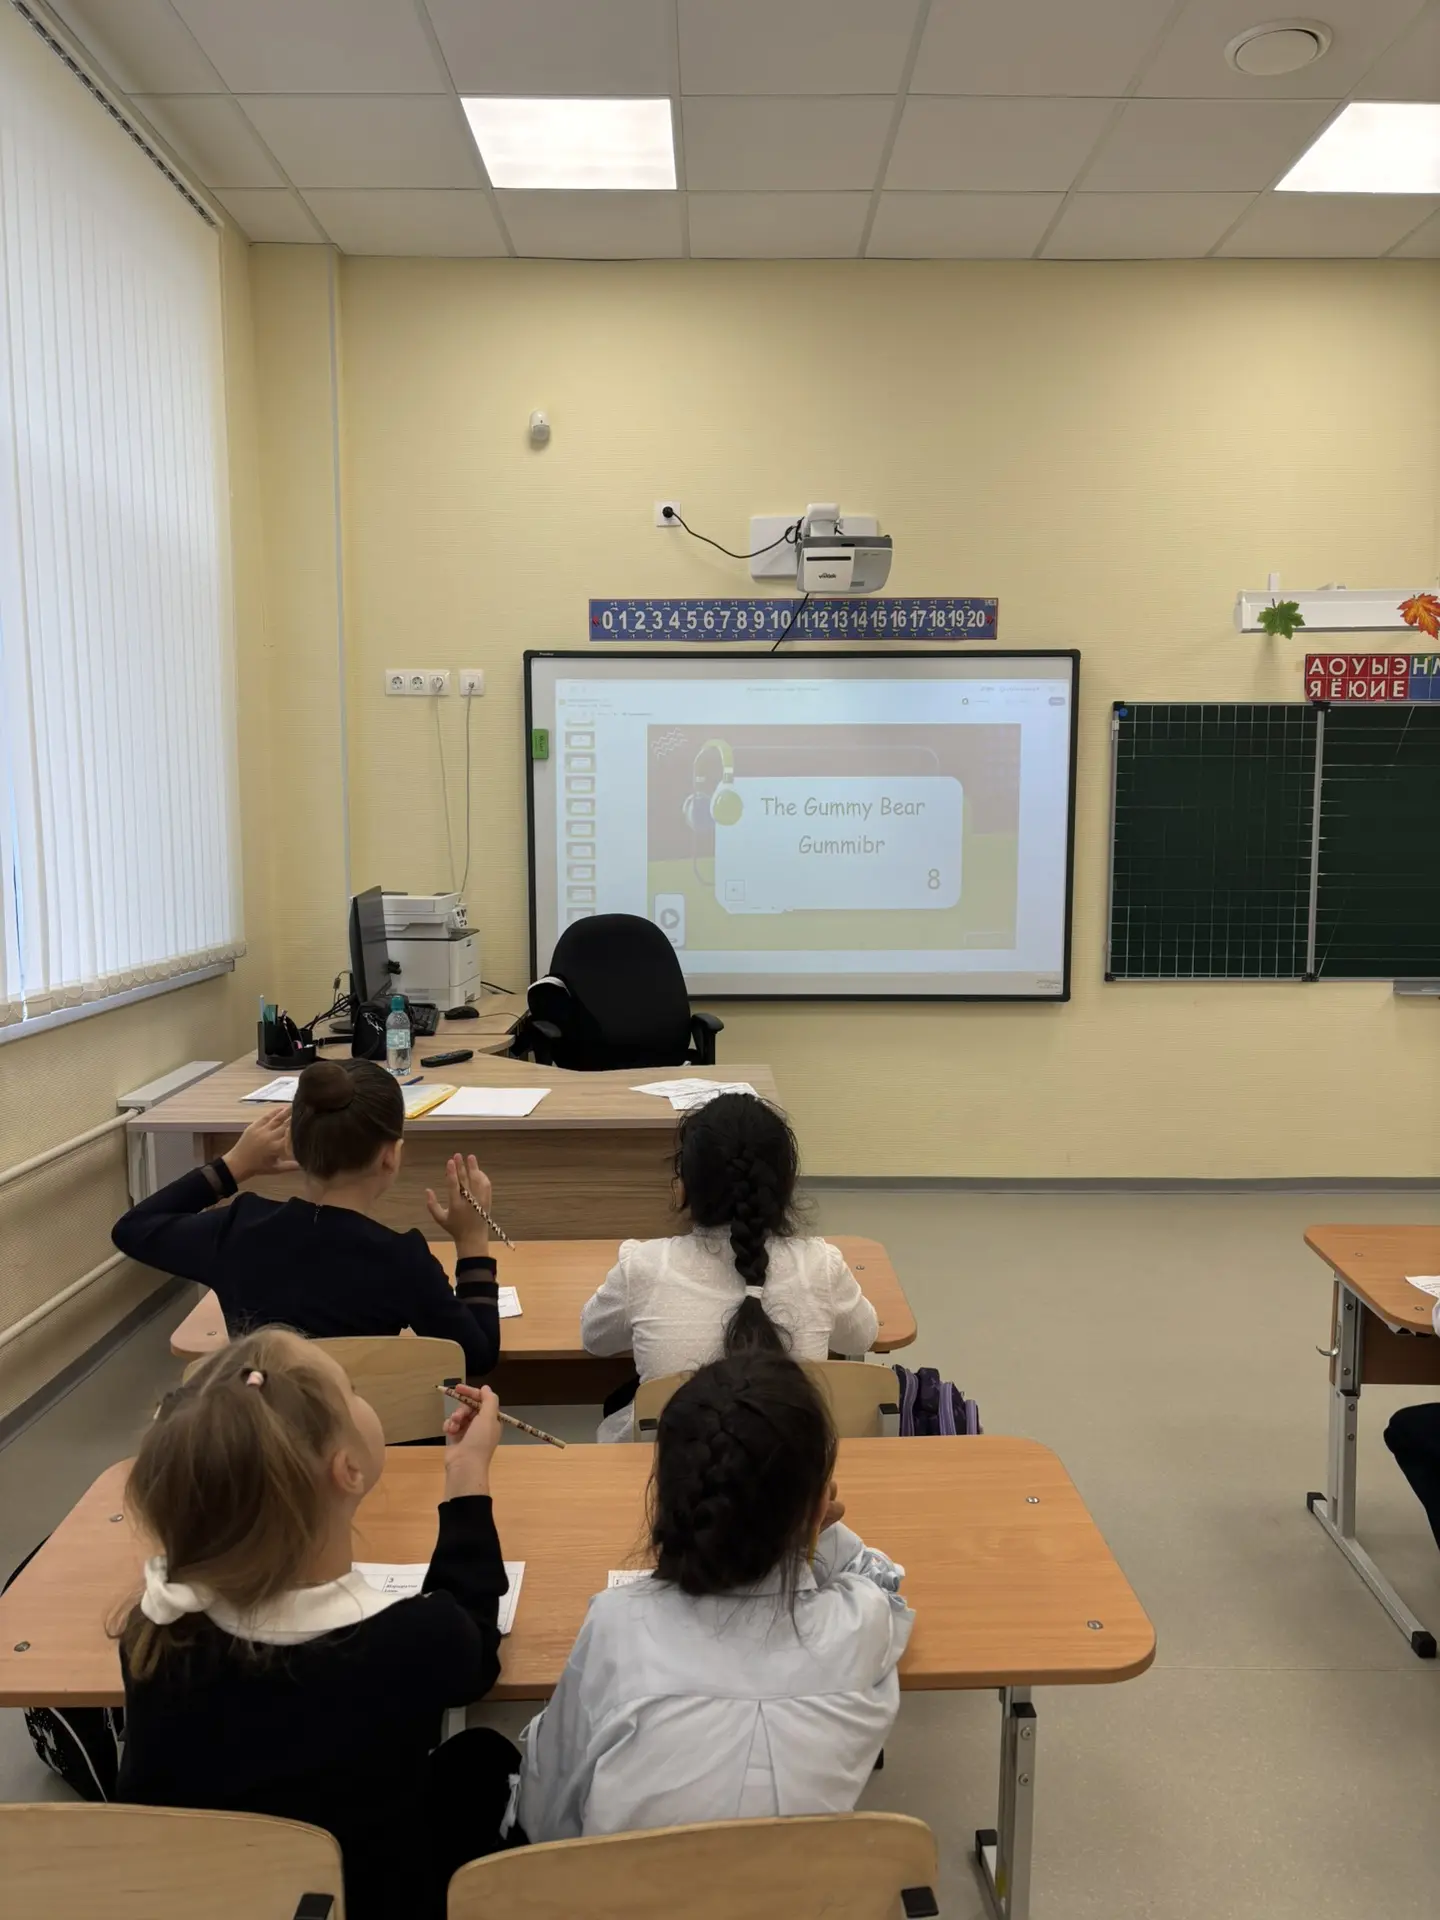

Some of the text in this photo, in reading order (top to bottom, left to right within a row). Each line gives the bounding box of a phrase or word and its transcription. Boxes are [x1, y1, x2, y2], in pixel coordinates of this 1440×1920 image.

[602, 610, 985, 630] 0 1 2 3 4 5 6 7 8 9 10 11 12 13 14 15 16 17 18 19 20
[761, 796, 925, 821] The Gummy Bear
[798, 835, 885, 855] Gummibr
[927, 868, 941, 890] 8
